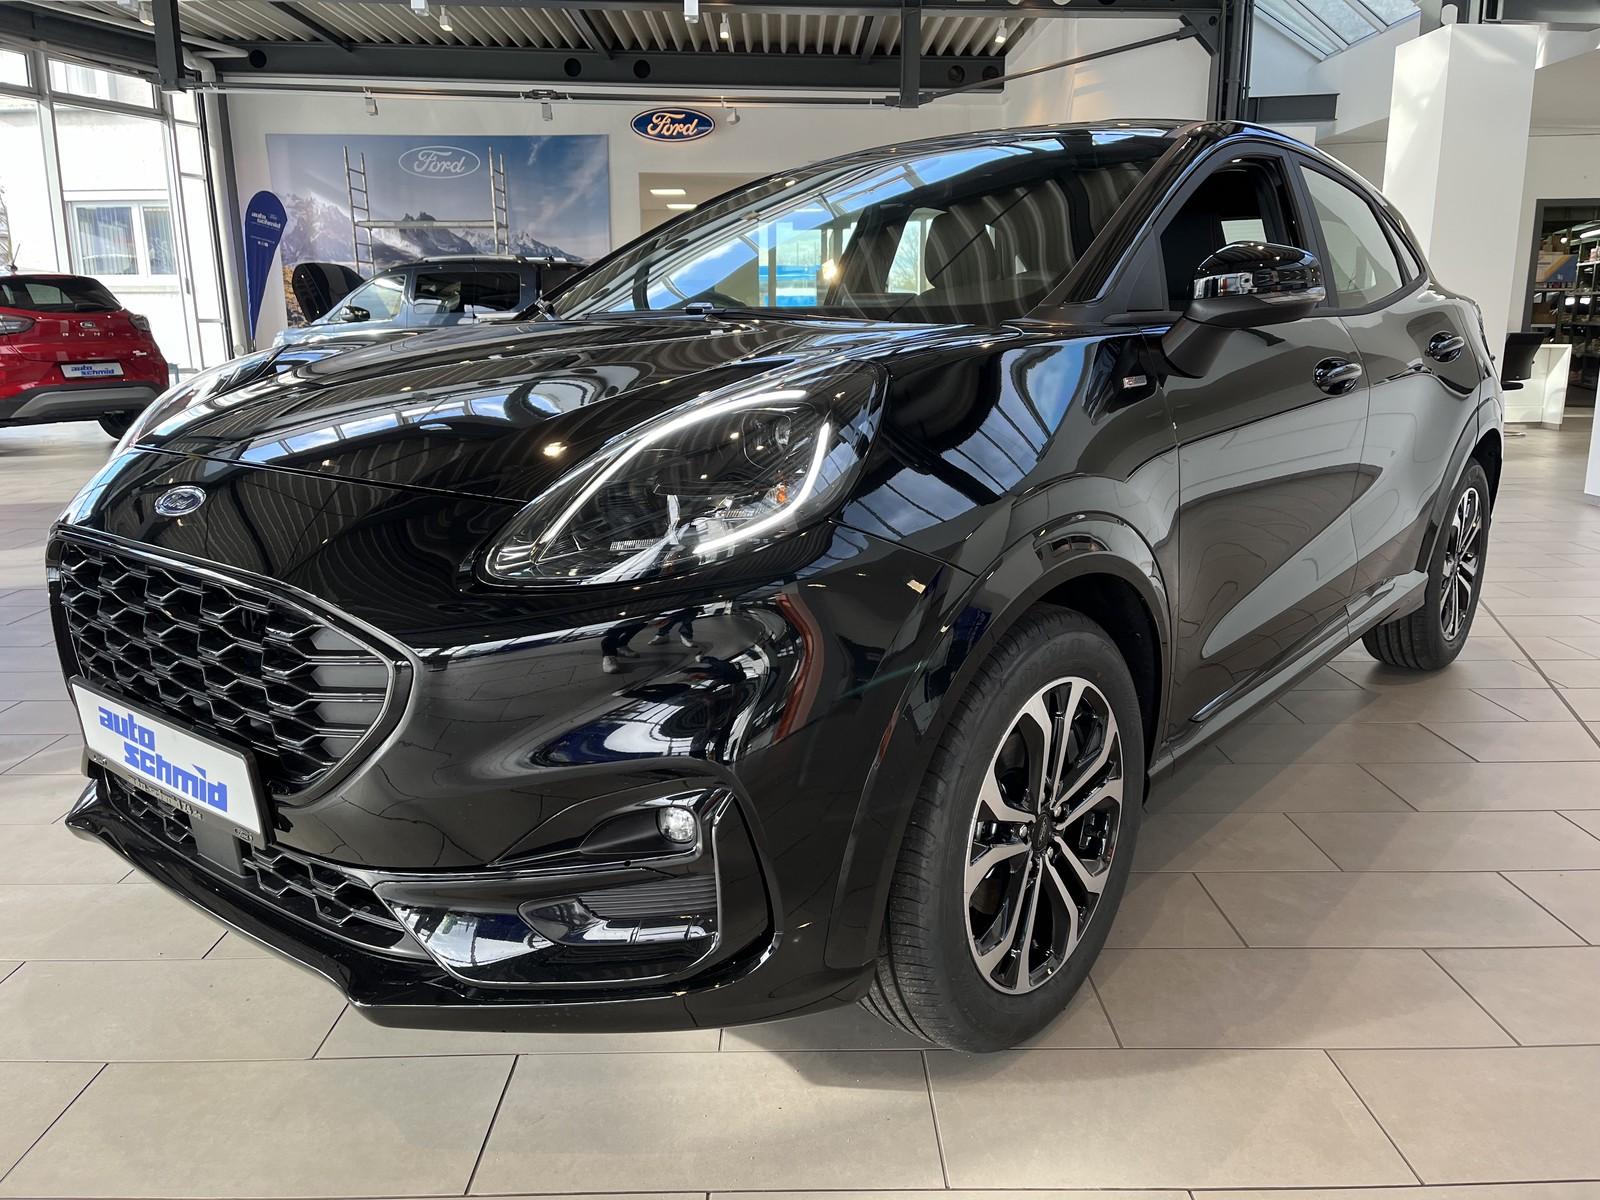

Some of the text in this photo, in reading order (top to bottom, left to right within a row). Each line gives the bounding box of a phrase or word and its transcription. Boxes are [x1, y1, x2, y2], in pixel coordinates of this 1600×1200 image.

[647, 112, 699, 136] Ford
[414, 150, 466, 173] Ford
[98, 706, 155, 752] auto
[123, 741, 228, 813] schmid
